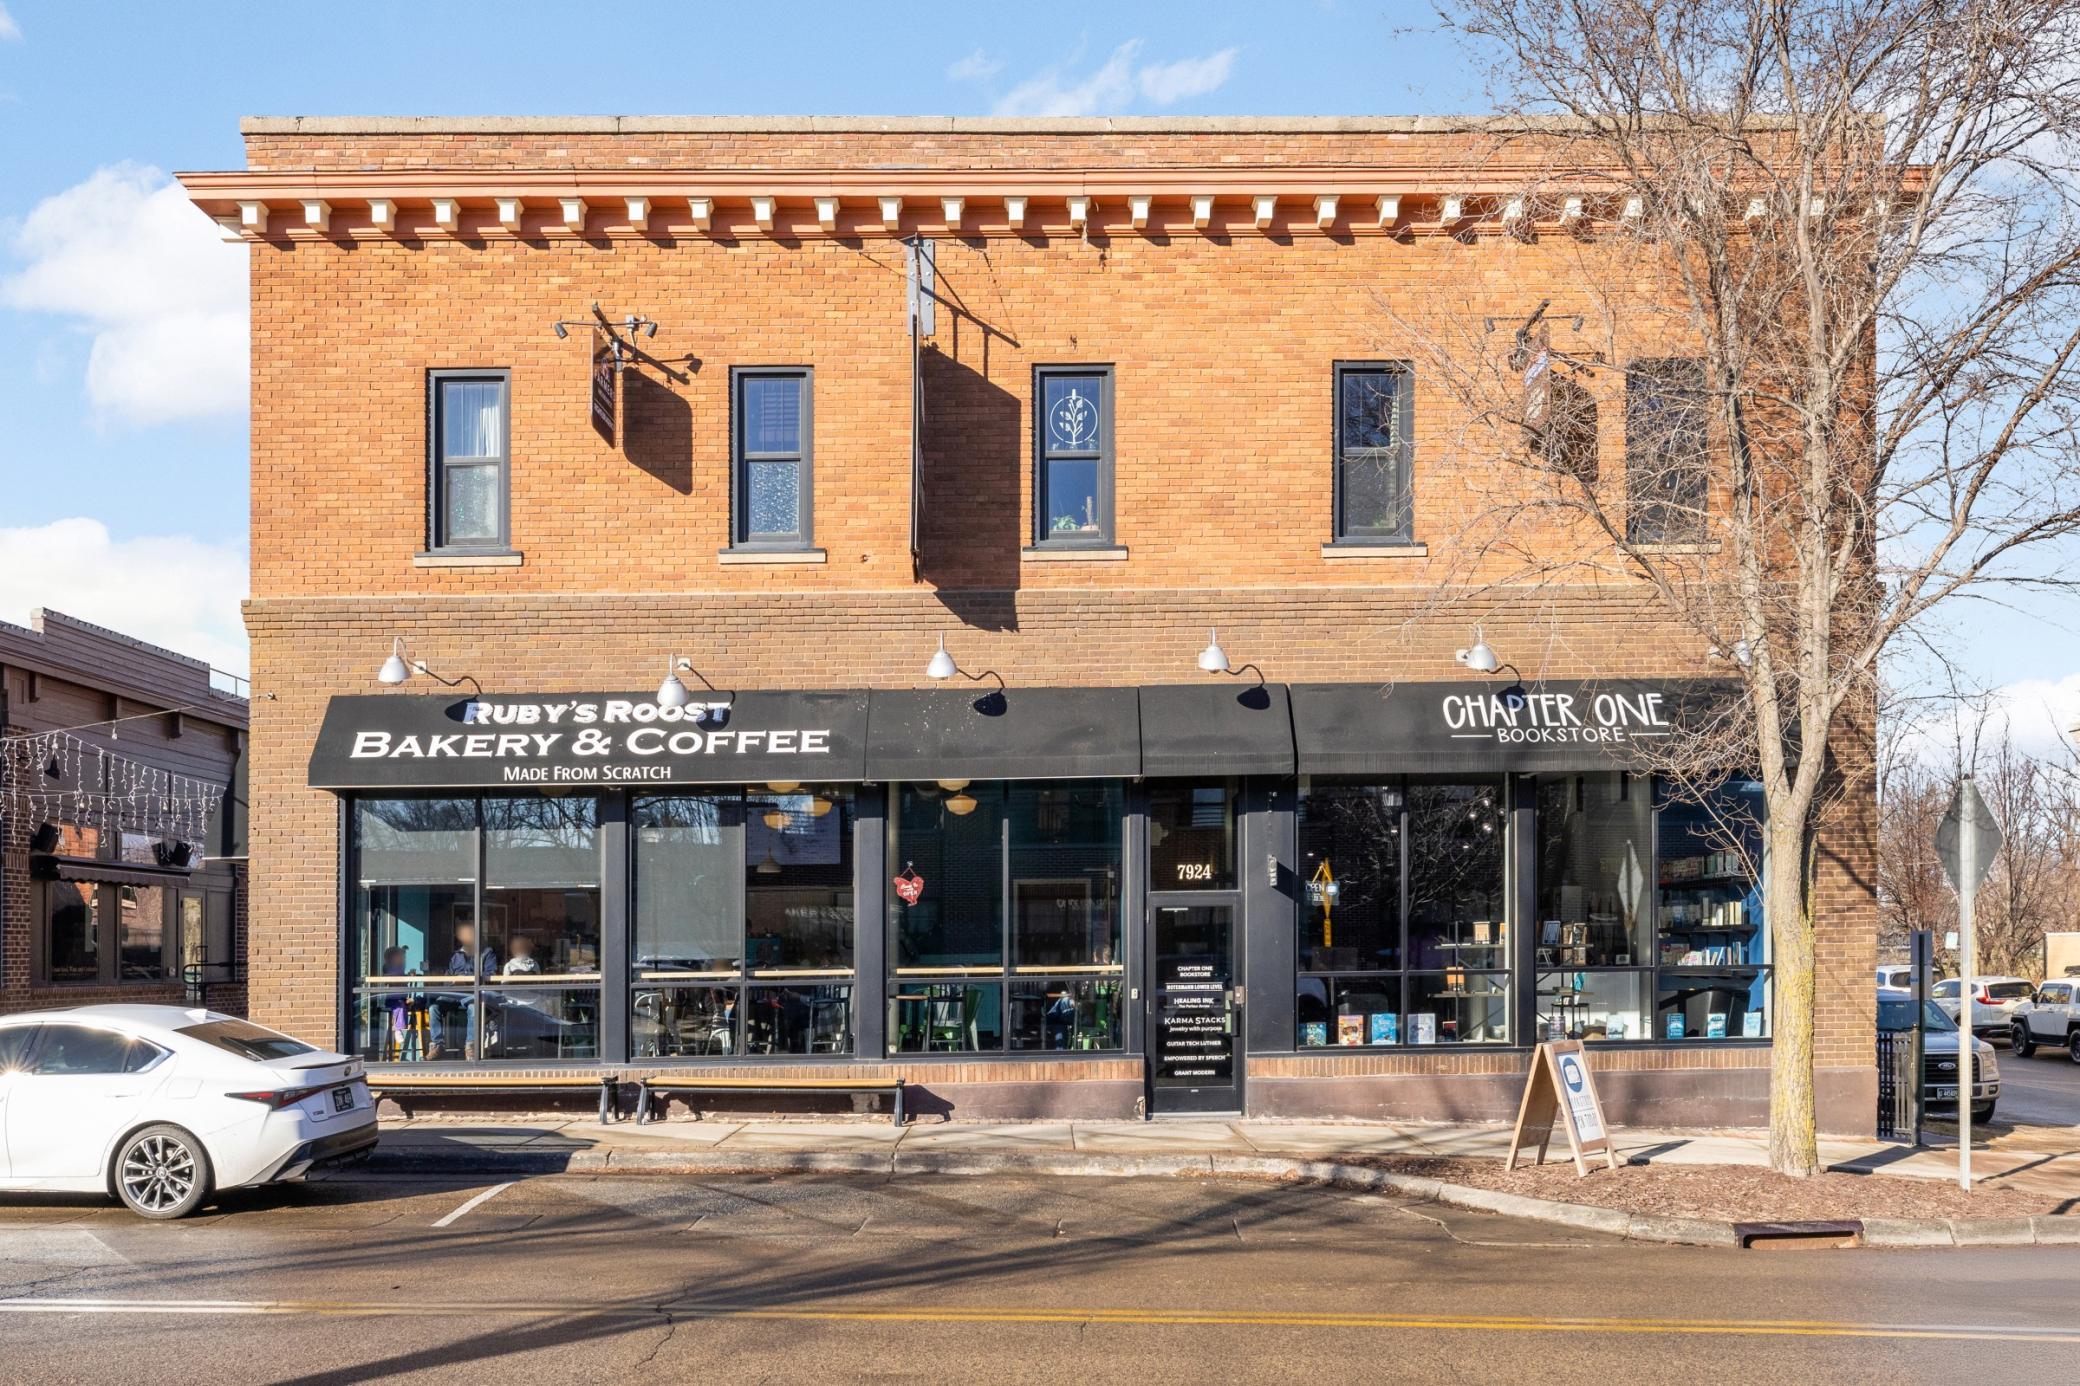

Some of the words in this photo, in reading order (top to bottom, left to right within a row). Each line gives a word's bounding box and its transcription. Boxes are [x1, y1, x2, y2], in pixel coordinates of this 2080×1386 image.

[463, 700, 598, 725] RUBY'S
[603, 700, 732, 724] ROOST
[1442, 693, 1582, 729] CHAPTER
[1594, 693, 1670, 726] ONE
[1498, 727, 1626, 743] BOOKSTORE
[350, 731, 563, 759] BAKERY
[571, 728, 611, 757] &
[626, 728, 831, 756] COFFEE
[504, 766, 549, 782] MADE
[554, 766, 598, 781] FROM
[602, 765, 671, 780] SCRATCH
[1177, 864, 1212, 880] 7924
[1173, 997, 1201, 1005] HEALING
[1164, 1017, 1194, 1025] KARMA
[1195, 1016, 1226, 1025] STACKS
